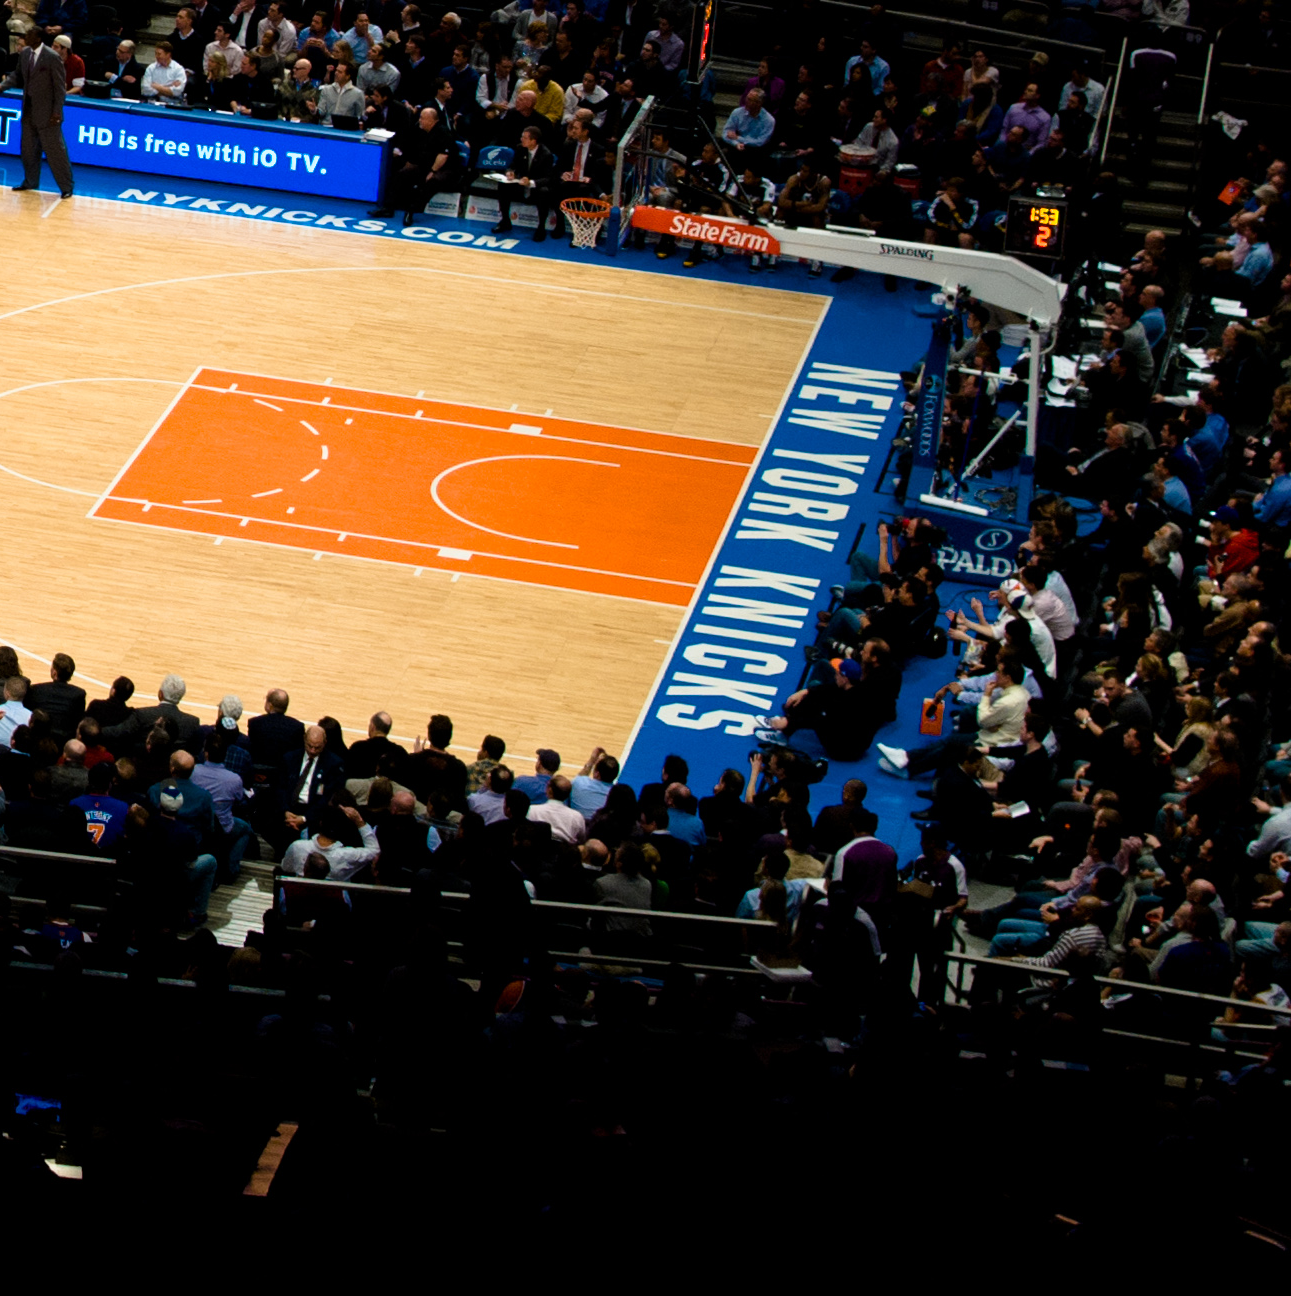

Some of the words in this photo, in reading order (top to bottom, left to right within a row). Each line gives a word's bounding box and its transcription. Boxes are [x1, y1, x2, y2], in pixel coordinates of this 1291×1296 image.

[78, 125, 113, 146] HD
[119, 130, 138, 151] is
[144, 133, 191, 157] free
[196, 141, 247, 165] with
[252, 147, 278, 167] iO
[285, 151, 328, 175] TV.
[117, 187, 521, 251] NYKNICKS.COM
[667, 213, 770, 253] StateFarm
[1029, 206, 1060, 226] 1:53
[1034, 226, 1052, 248] 2
[878, 243, 934, 261] SPALDING
[786, 361, 902, 441] NEW
[733, 447, 871, 553] YORK
[655, 563, 822, 737] KNICKS
[86, 822, 106, 845] 7
